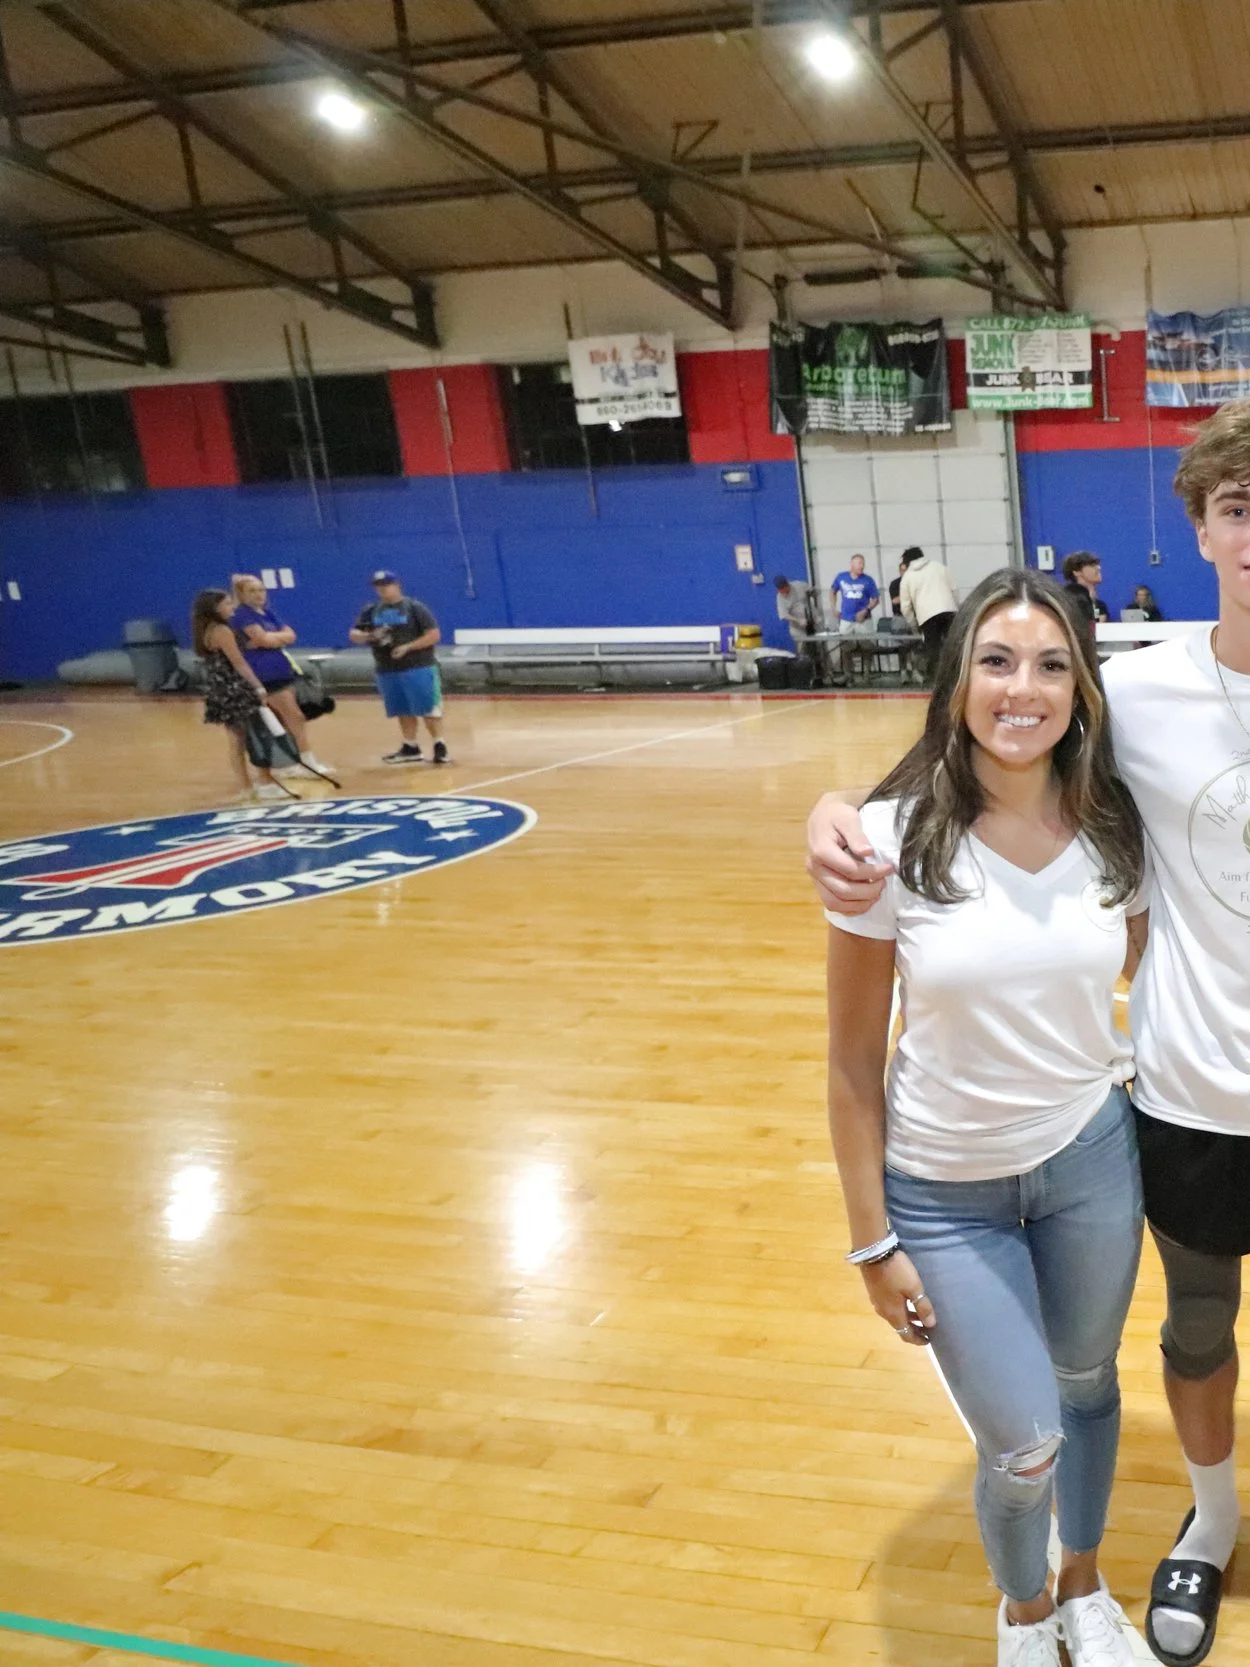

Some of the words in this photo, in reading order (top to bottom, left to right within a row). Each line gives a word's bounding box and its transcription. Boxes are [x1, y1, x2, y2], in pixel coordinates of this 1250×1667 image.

[971, 333, 1015, 354] JUNK
[801, 362, 906, 385] Arboretum
[985, 373, 1020, 386] JUNK
[1035, 371, 1074, 385] BEAR
[206, 799, 504, 829] BRISTOL
[1219, 871, 1242, 881] Aim
[0, 850, 436, 939] RMORY
